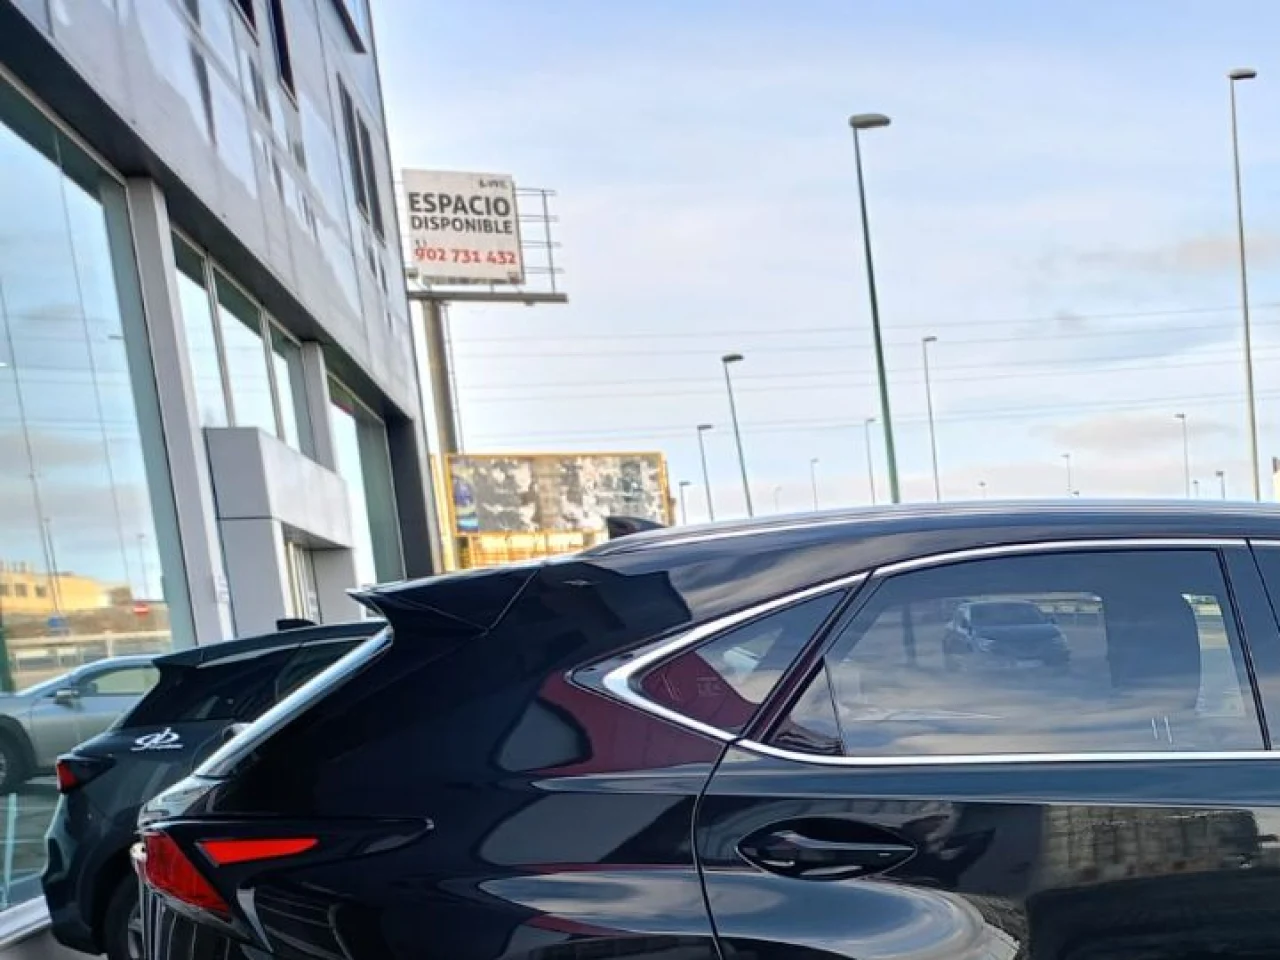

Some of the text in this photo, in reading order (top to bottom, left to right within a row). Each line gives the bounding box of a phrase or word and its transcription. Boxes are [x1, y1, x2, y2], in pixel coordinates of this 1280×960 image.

[408, 192, 511, 216] ESPACIO
[411, 216, 513, 234] DISPONIBLE
[415, 247, 517, 264] 902 731 432
